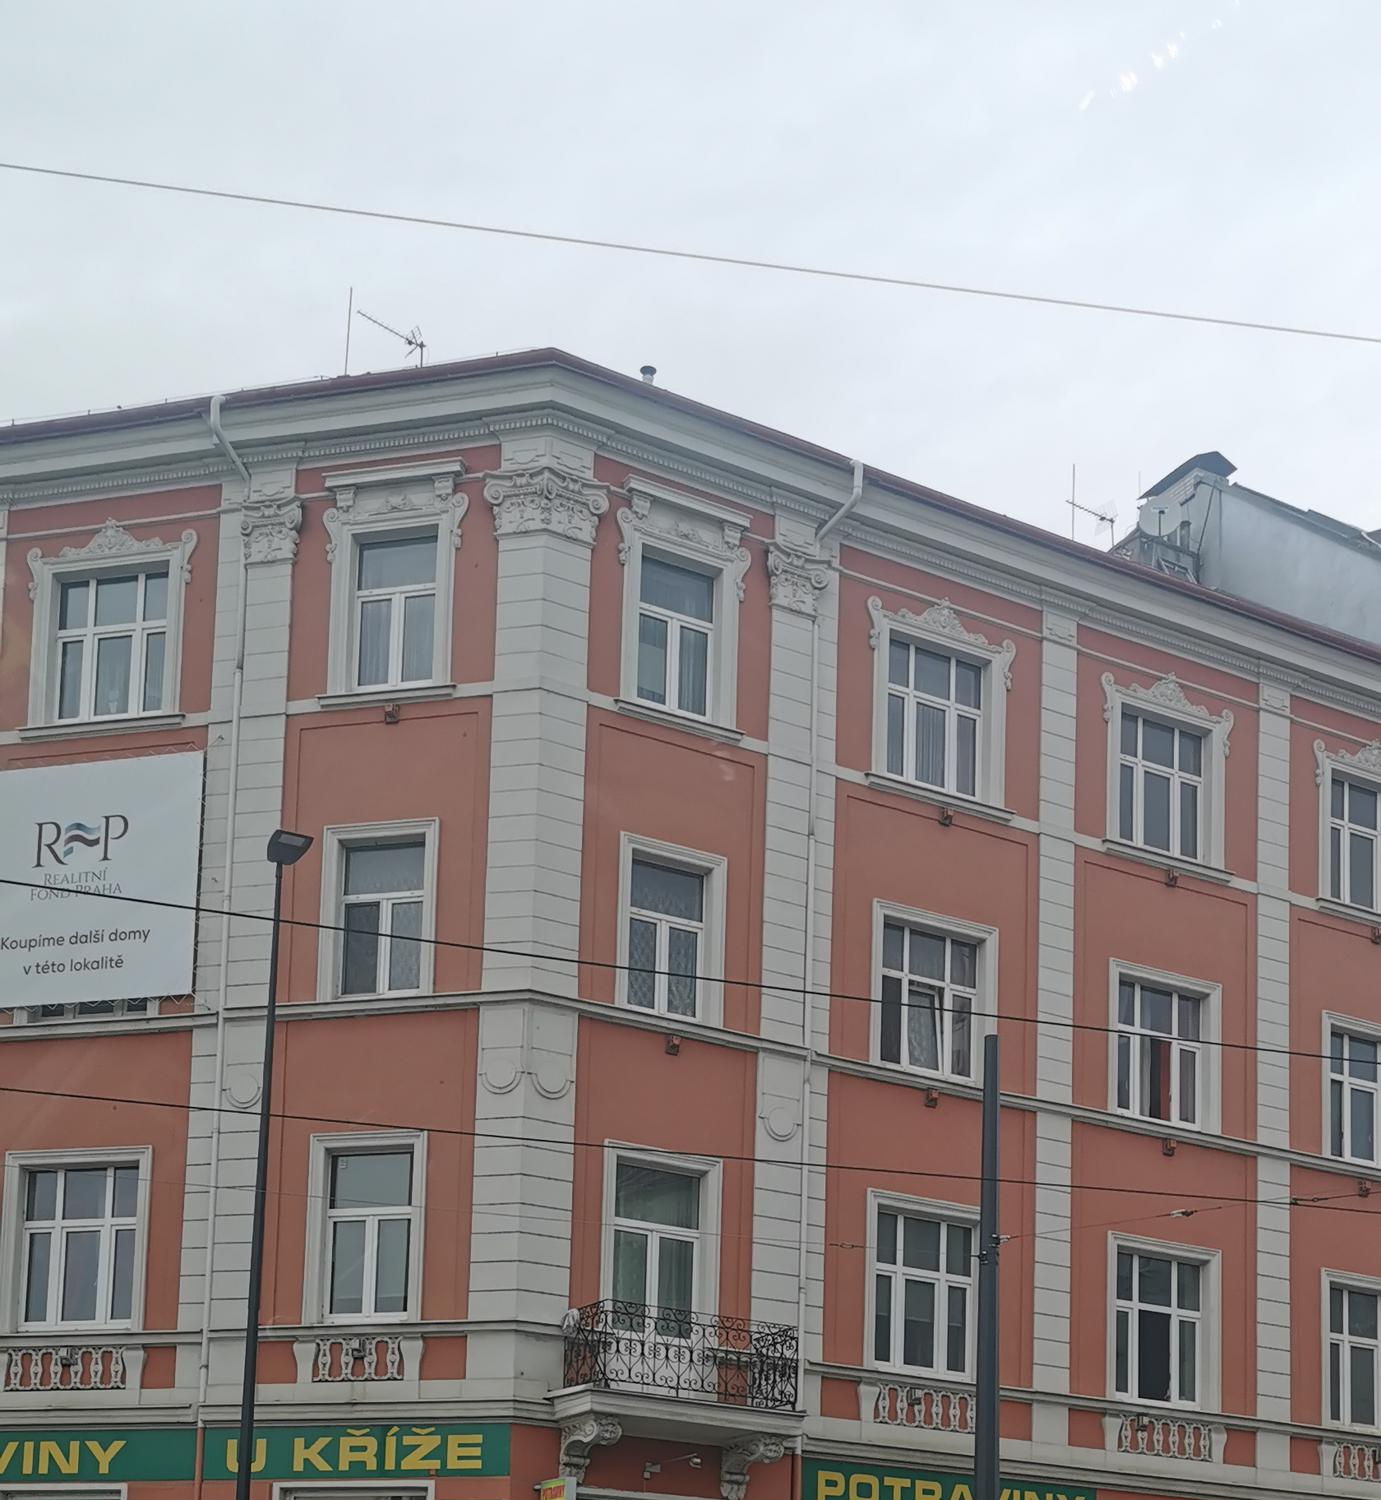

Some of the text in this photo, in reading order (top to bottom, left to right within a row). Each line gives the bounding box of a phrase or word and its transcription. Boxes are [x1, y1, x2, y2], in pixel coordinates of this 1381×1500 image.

[43, 867, 108, 886] REALITNÍ
[30, 883, 123, 901] FOND PRAHA
[0, 928, 151, 952] Koupíme další domy
[23, 954, 124, 975] v této lokalitě
[226, 1426, 484, 1472] U KŘÍŽE
